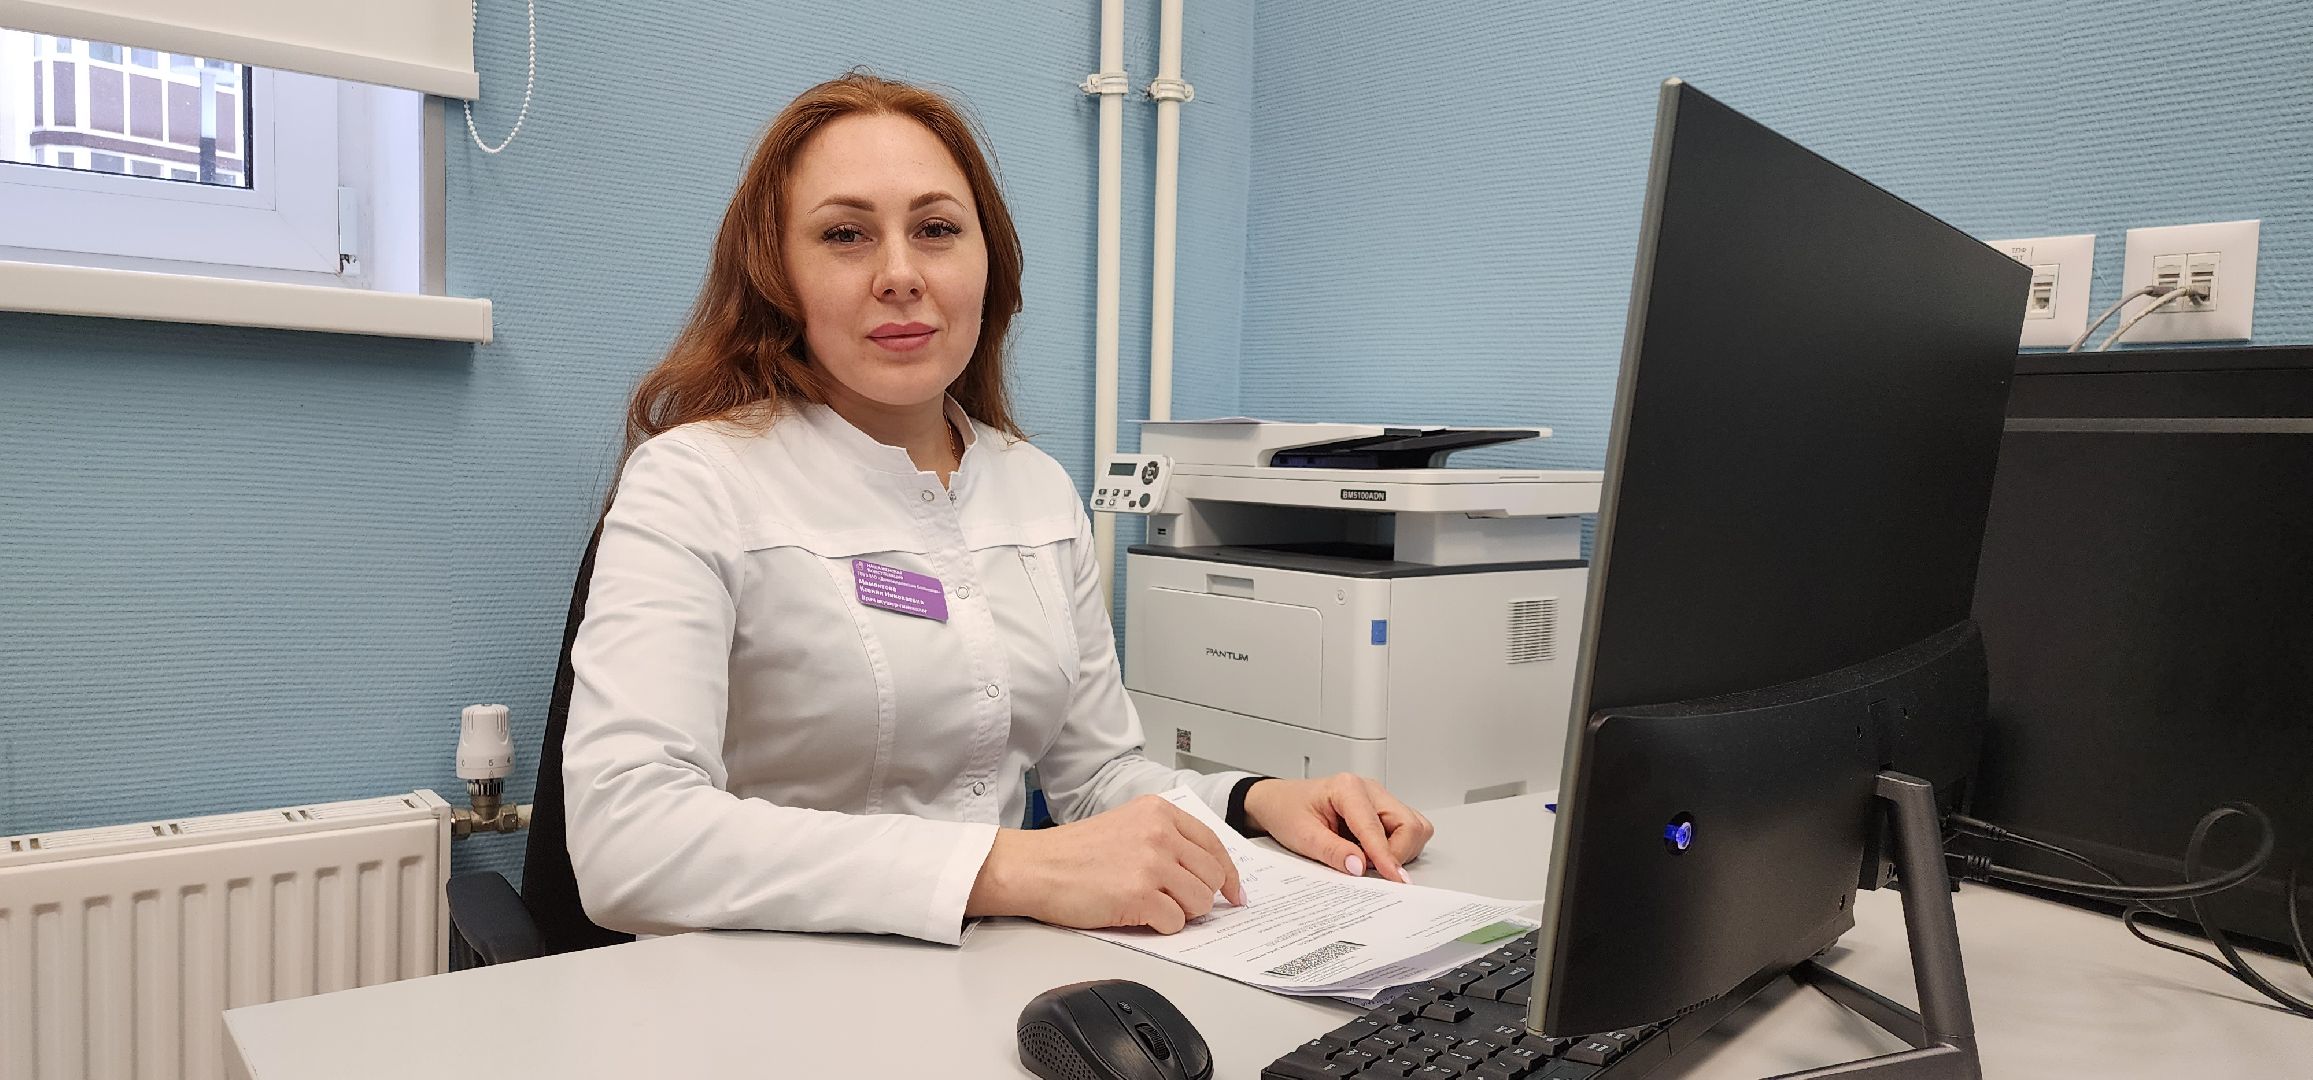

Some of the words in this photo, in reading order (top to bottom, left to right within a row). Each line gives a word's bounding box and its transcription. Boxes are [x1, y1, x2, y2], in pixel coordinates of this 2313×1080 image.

[1342, 490, 1385, 501] BM5100ADN
[1205, 647, 1249, 662] PANTUM
[488, 759, 495, 767] 5
